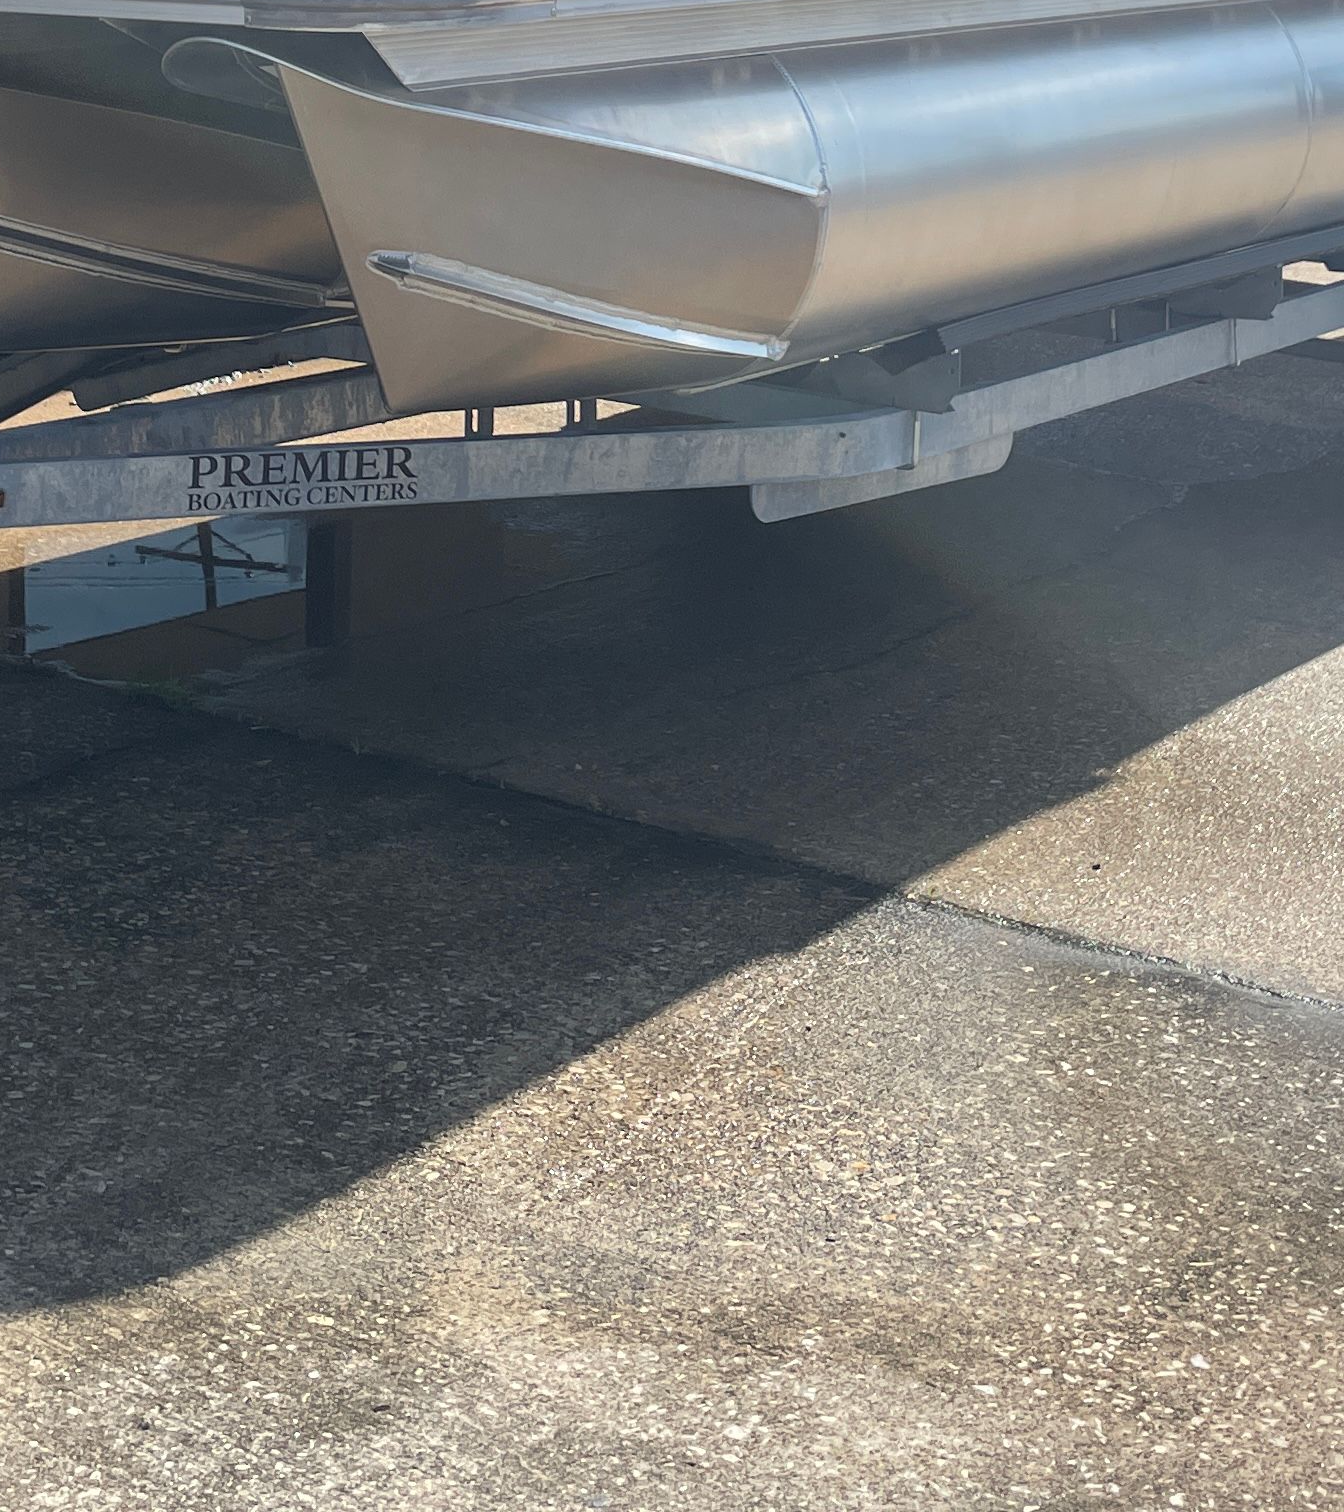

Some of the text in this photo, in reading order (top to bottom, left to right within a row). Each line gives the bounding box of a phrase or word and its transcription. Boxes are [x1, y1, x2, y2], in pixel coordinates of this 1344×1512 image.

[187, 445, 418, 490] PREMIER
[187, 481, 418, 513] BOATING CENTERS
